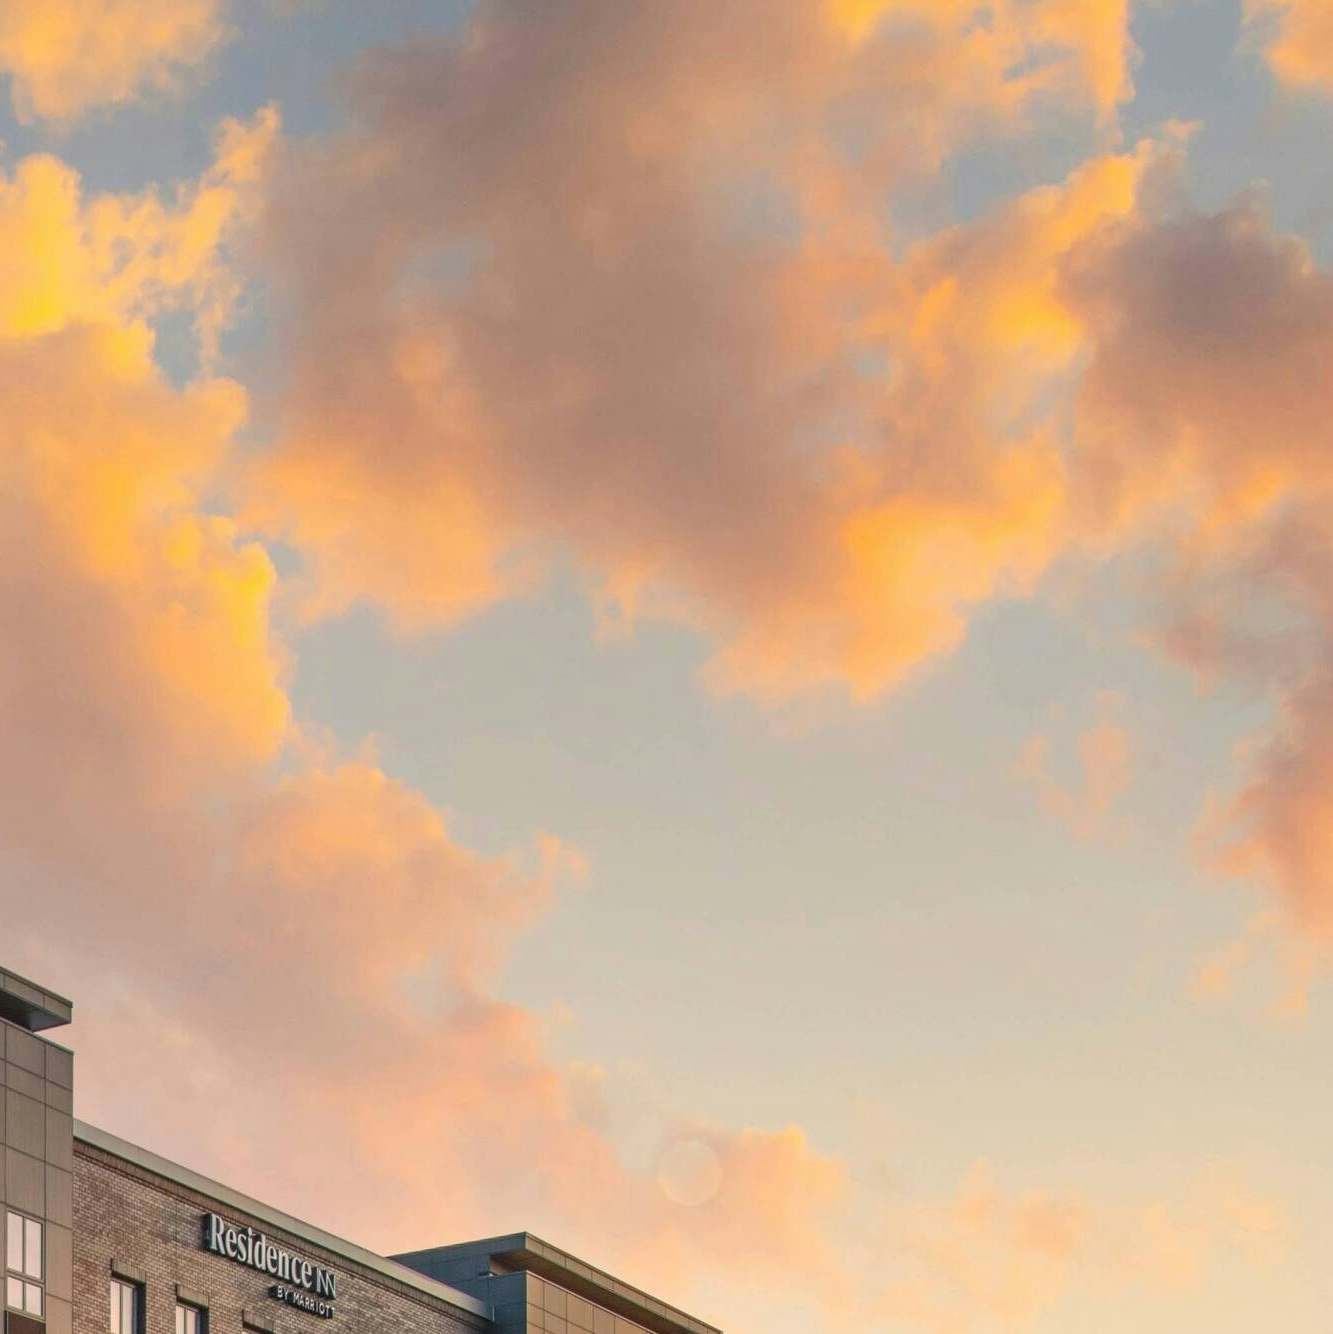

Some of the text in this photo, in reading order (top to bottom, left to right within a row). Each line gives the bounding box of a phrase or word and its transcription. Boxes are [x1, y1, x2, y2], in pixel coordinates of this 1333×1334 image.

[210, 1213, 312, 1288] Residence
[277, 1285, 336, 1318] BY MARRIOTT
